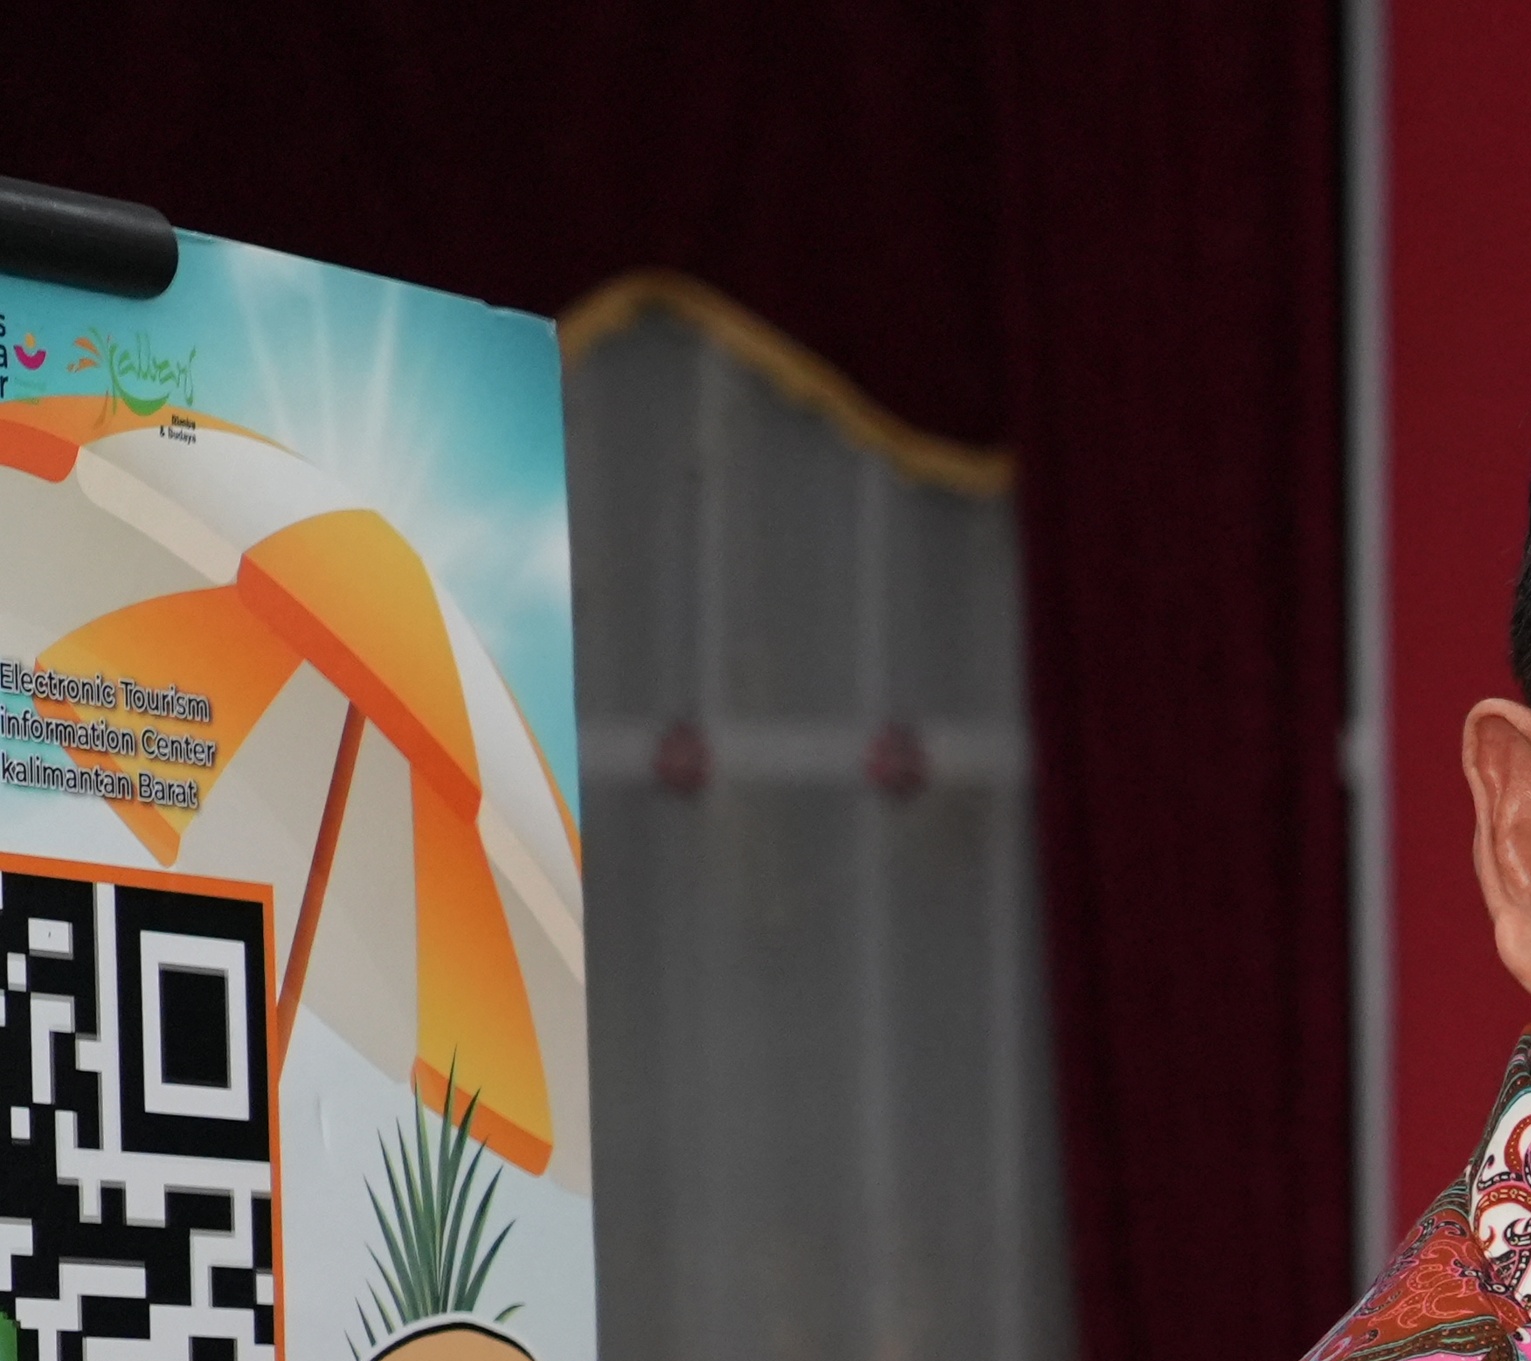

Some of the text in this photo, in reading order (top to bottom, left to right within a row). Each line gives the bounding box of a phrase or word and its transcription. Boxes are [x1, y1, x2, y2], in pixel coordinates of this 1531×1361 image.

[0, 661, 210, 721] Electronic Tourism
[0, 705, 215, 766] information Center
[1, 752, 198, 807] kalimantan Barat
